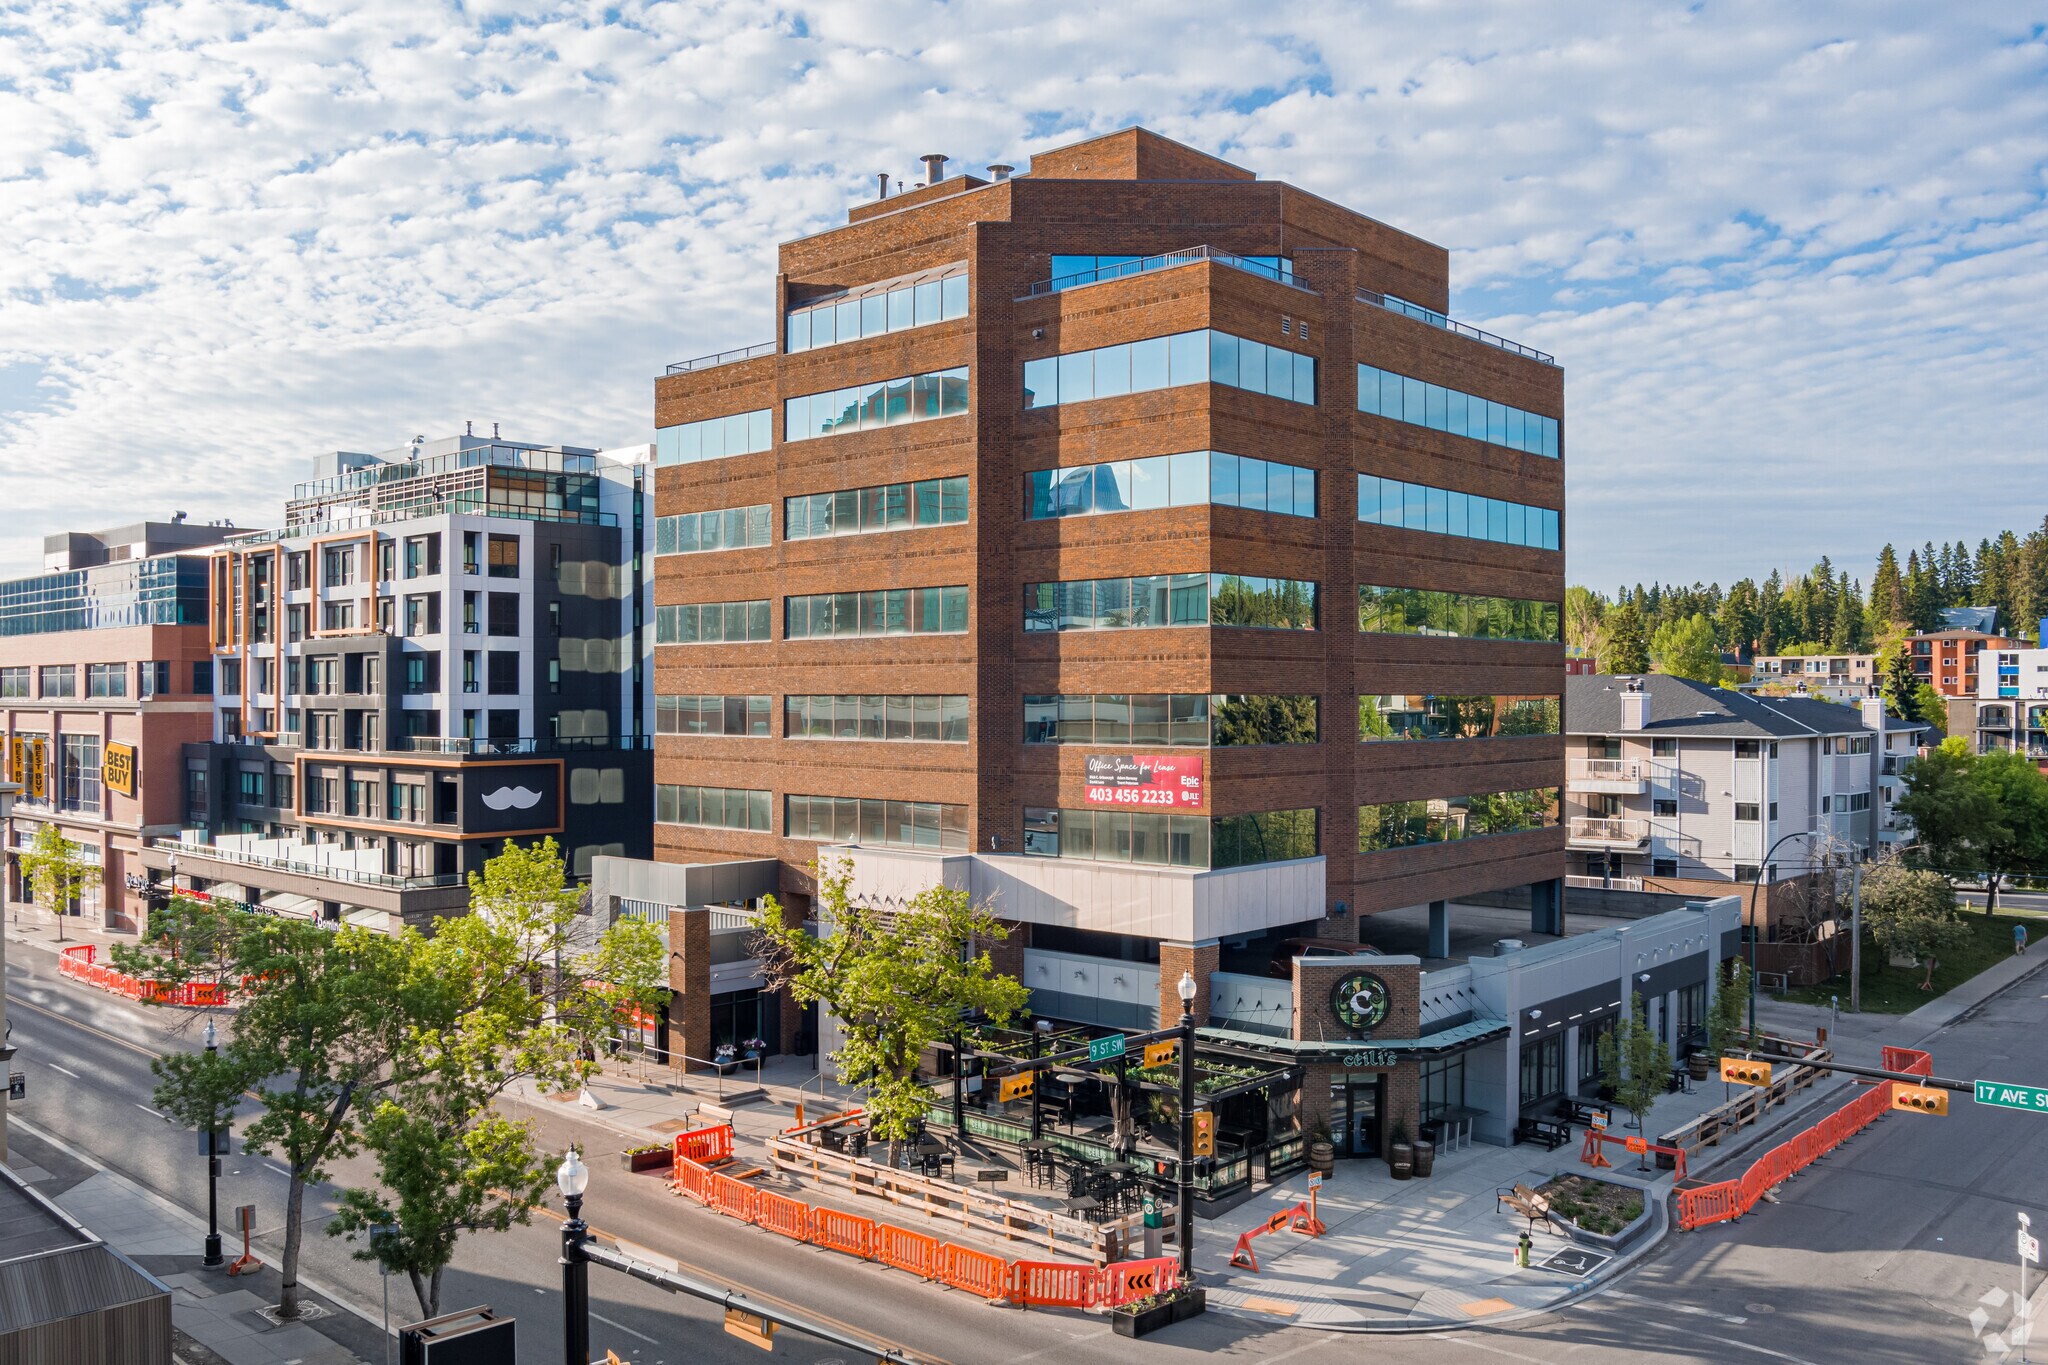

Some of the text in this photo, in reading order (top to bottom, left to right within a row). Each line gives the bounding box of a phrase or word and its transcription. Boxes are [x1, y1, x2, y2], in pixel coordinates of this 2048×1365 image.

[107, 750, 131, 771] BEST
[1089, 758, 1176, 775] Office Space for Lease
[108, 764, 129, 786] BUY
[1180, 776, 1199, 788] Epic
[1089, 788, 1174, 805] 403 456 2233
[317, 916, 342, 932] Domin
[1091, 1039, 1123, 1057] 9 ST SW
[1979, 1085, 2048, 1108] 17 AVE S
